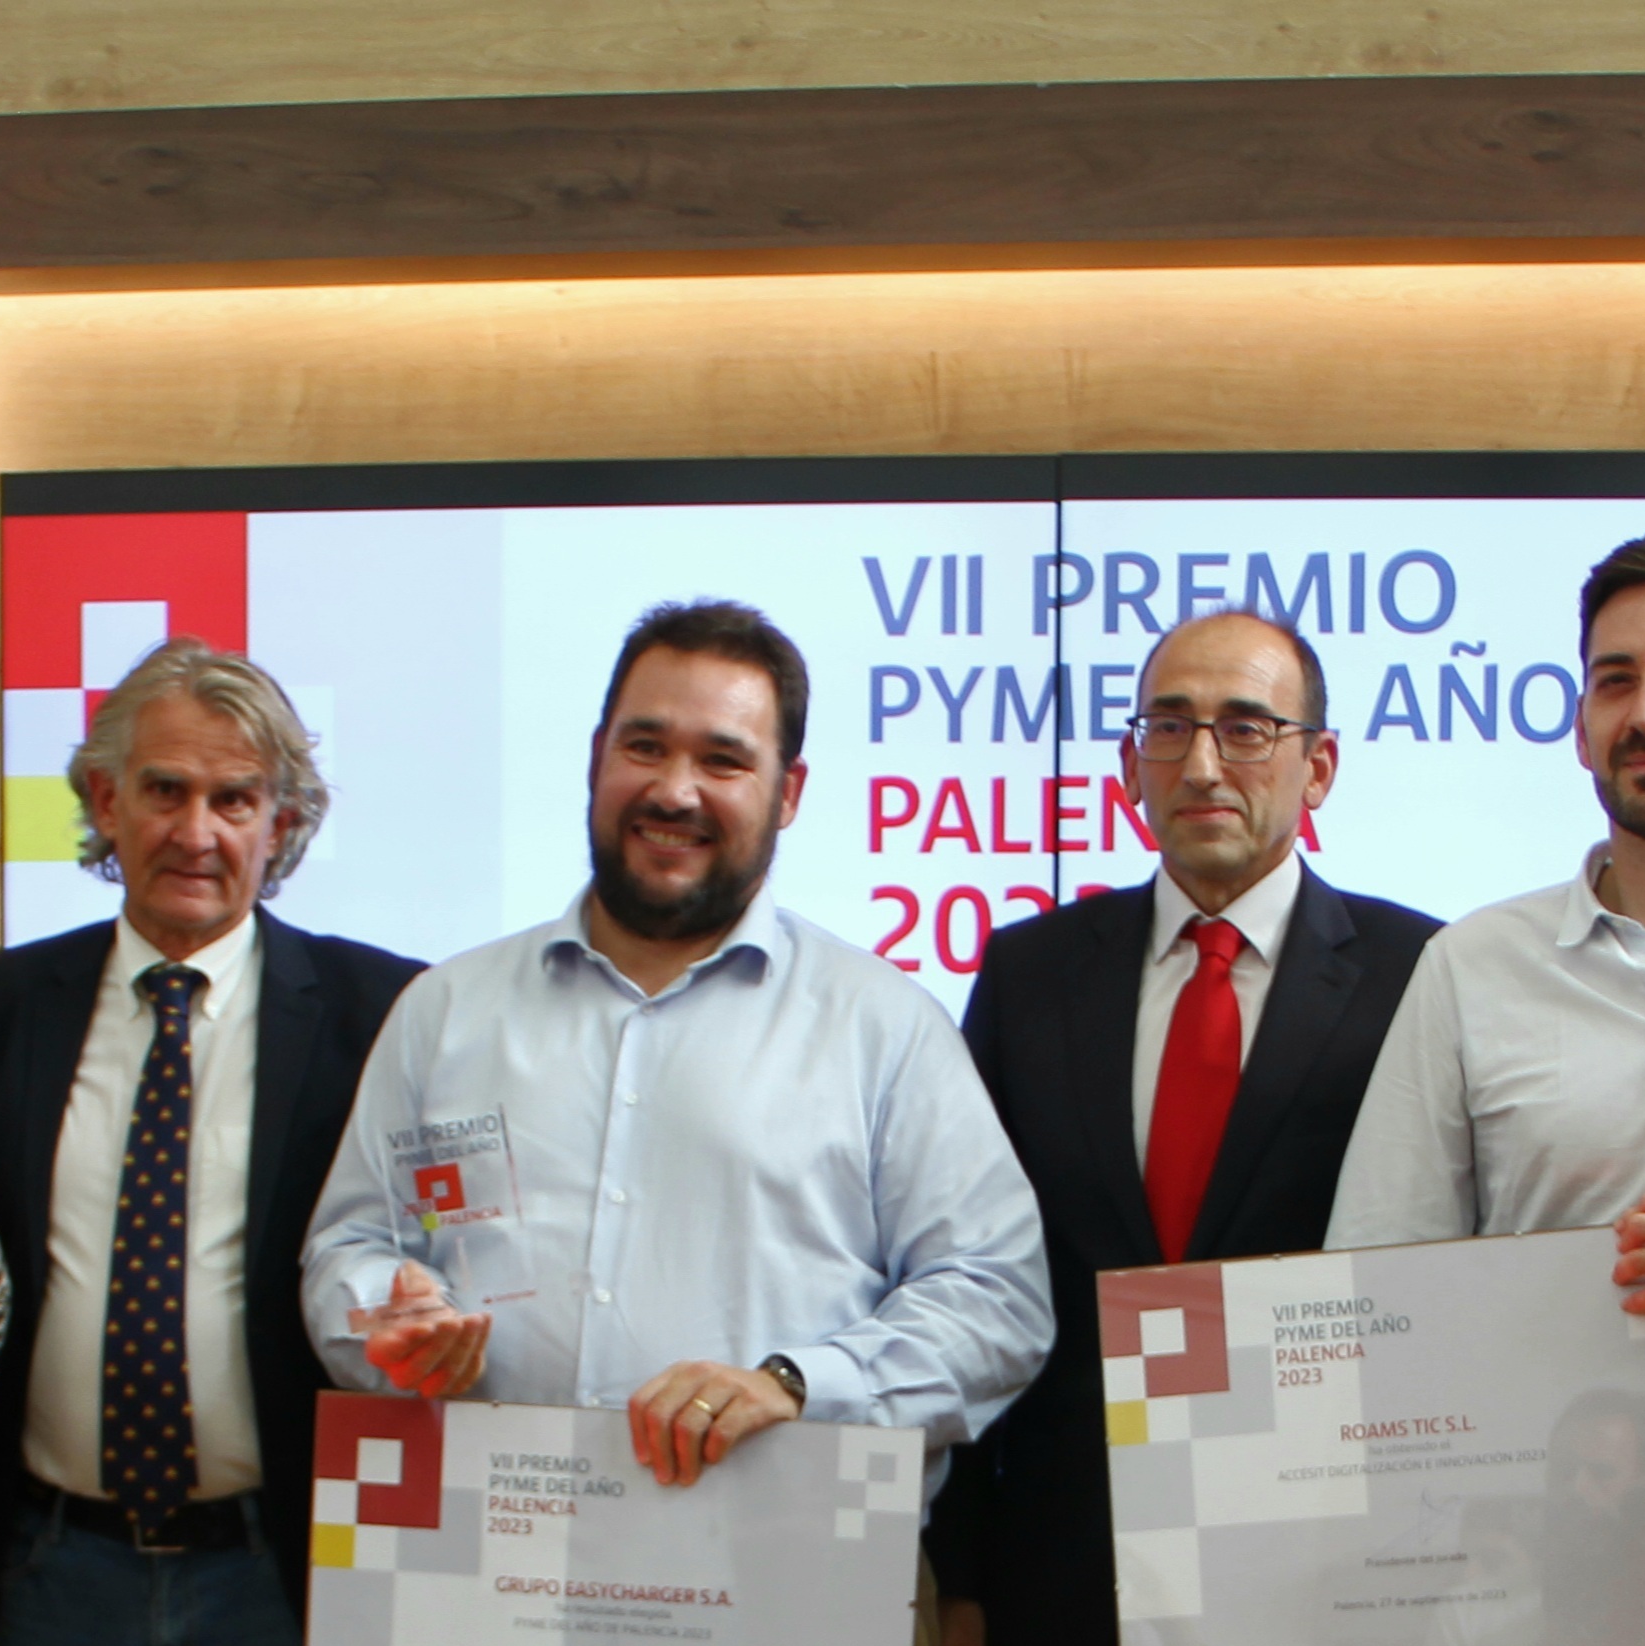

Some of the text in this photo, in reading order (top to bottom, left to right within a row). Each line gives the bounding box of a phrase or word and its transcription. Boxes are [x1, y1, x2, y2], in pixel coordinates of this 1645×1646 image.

[862, 549, 1458, 636] VII PREMIO
[869, 641, 1576, 745] PYME AÑO
[868, 776, 1322, 853] PALEN
[870, 885, 1114, 974] 20
[1272, 1297, 1374, 1322] VII PREMIO
[1275, 1313, 1410, 1343] PYME DEL AÑO
[1276, 1342, 1365, 1365] PALENCIA
[1278, 1367, 1322, 1386] 2023
[1341, 1415, 1477, 1441] ROAMS TIC S.L.
[490, 1453, 591, 1473] VII PREMIO
[489, 1473, 625, 1497] PYME DEL AÑO
[488, 1495, 578, 1515] PALENCIA
[488, 1516, 533, 1534] 2023
[495, 1576, 733, 1606] GRUPO EASYCHARGER S.A.
